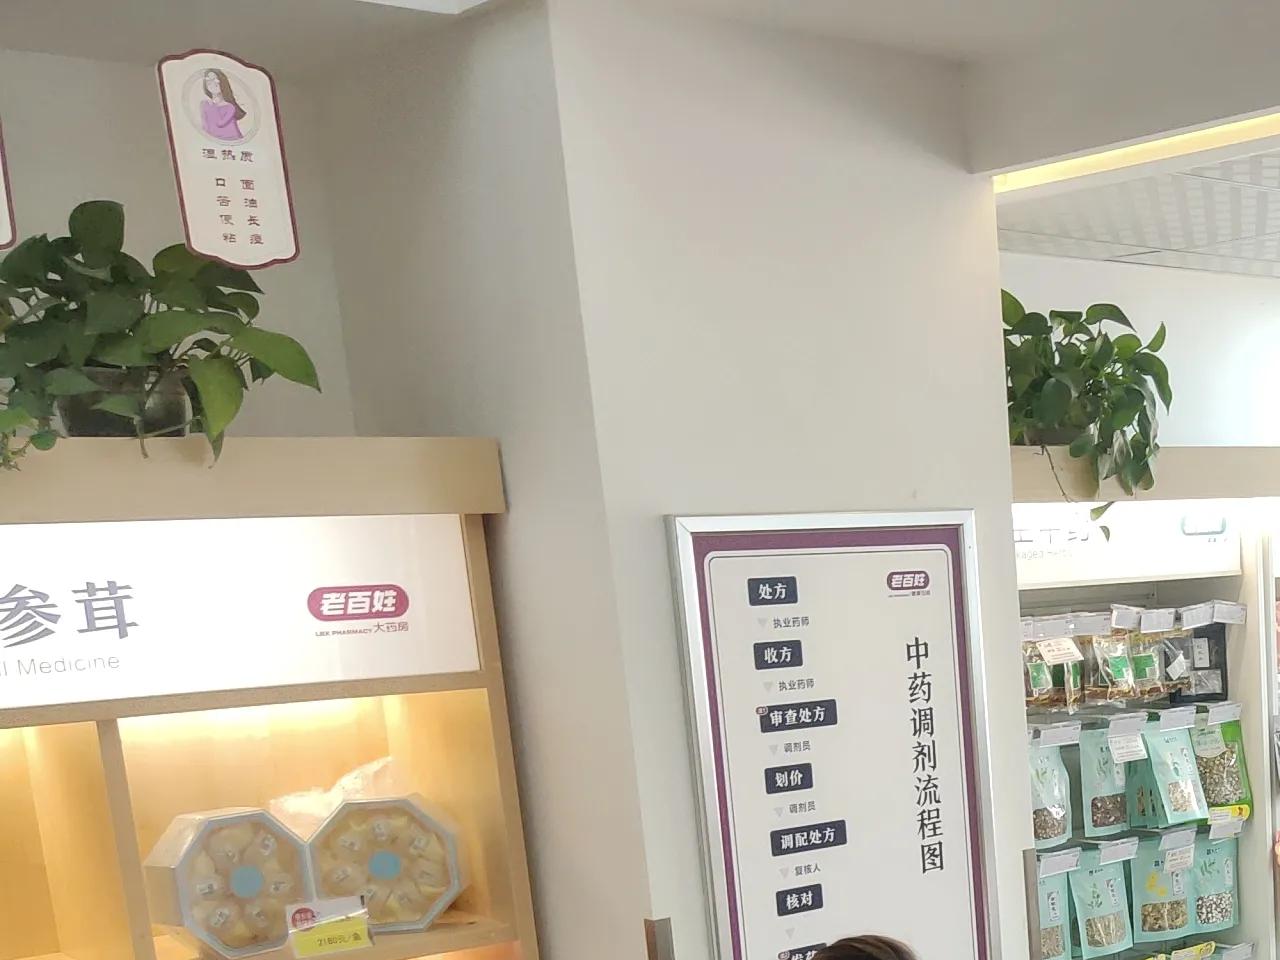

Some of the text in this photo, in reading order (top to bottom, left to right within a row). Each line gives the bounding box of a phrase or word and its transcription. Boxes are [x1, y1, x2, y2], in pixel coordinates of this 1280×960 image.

[891, 573, 926, 588] 老百姓
[758, 583, 788, 600] 处方
[320, 589, 398, 616] 老百姓
[0, 580, 140, 648] 参茸
[773, 616, 810, 629] 执业药师
[373, 621, 409, 633] 大药房
[764, 646, 792, 664] 收方
[17, 656, 120, 676] Medicine
[778, 678, 815, 692] 执业药师
[769, 705, 826, 727] 审查处方
[783, 740, 811, 753] 调剂员
[905, 636, 944, 874] 中药调剂流程图
[775, 770, 803, 788] 划价
[780, 827, 835, 850] 调配处方
[794, 863, 822, 876] 复核人
[786, 889, 813, 910] 核对
